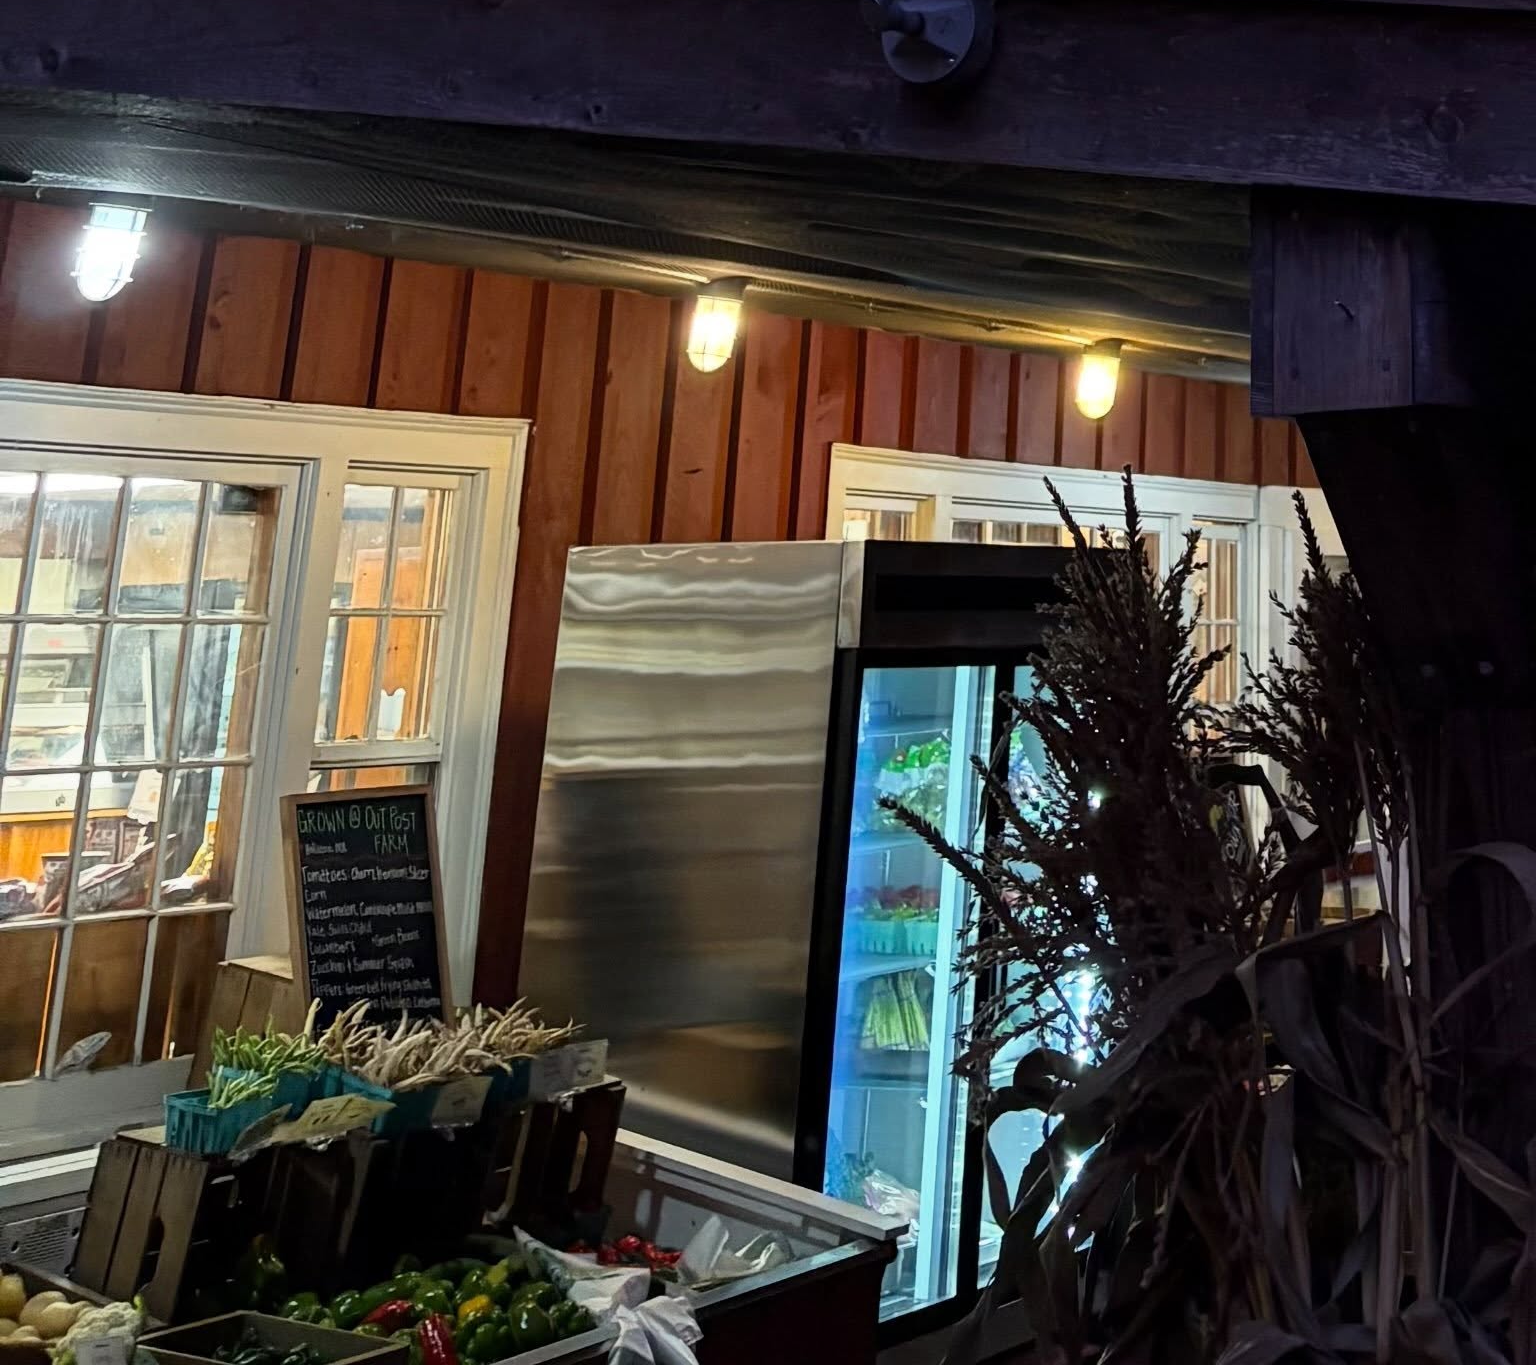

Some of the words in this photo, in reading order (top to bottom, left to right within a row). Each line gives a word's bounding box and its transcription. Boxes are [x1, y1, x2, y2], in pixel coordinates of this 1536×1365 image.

[298, 809, 345, 833] GROWN
[349, 804, 360, 829] @
[374, 833, 409, 855] FARM
[304, 889, 327, 903] Corn
